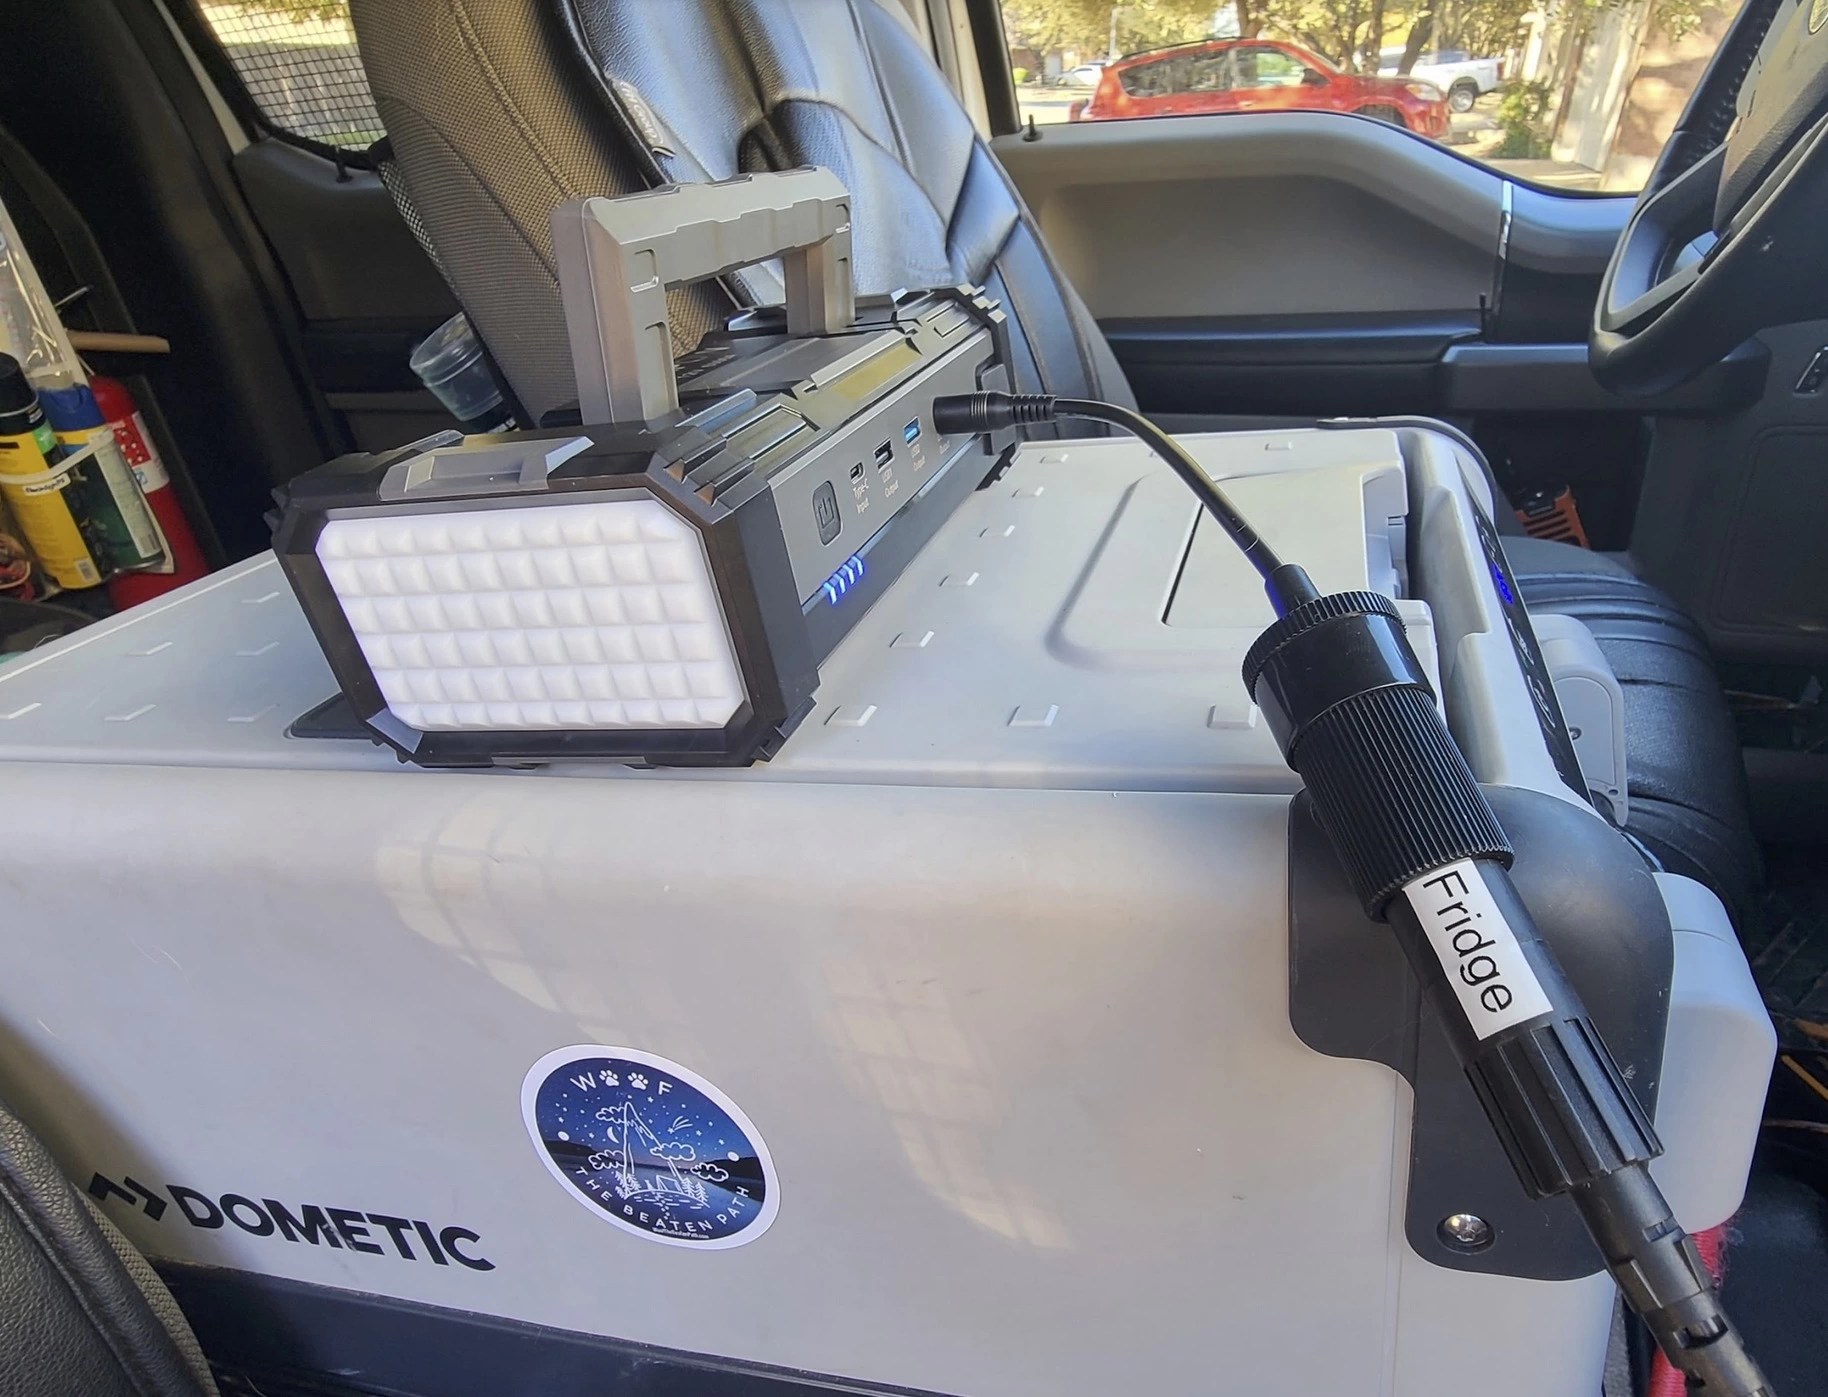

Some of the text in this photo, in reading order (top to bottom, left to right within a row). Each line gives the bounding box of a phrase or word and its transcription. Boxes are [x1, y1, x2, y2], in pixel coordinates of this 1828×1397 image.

[853, 478, 869, 500] Type-C
[856, 497, 870, 514] Input
[884, 480, 899, 498] Output
[1423, 870, 1513, 1013] Fridge
[575, 1166, 750, 1232] THE BEATEN PATH
[165, 1184, 497, 1271] DOMETIC
